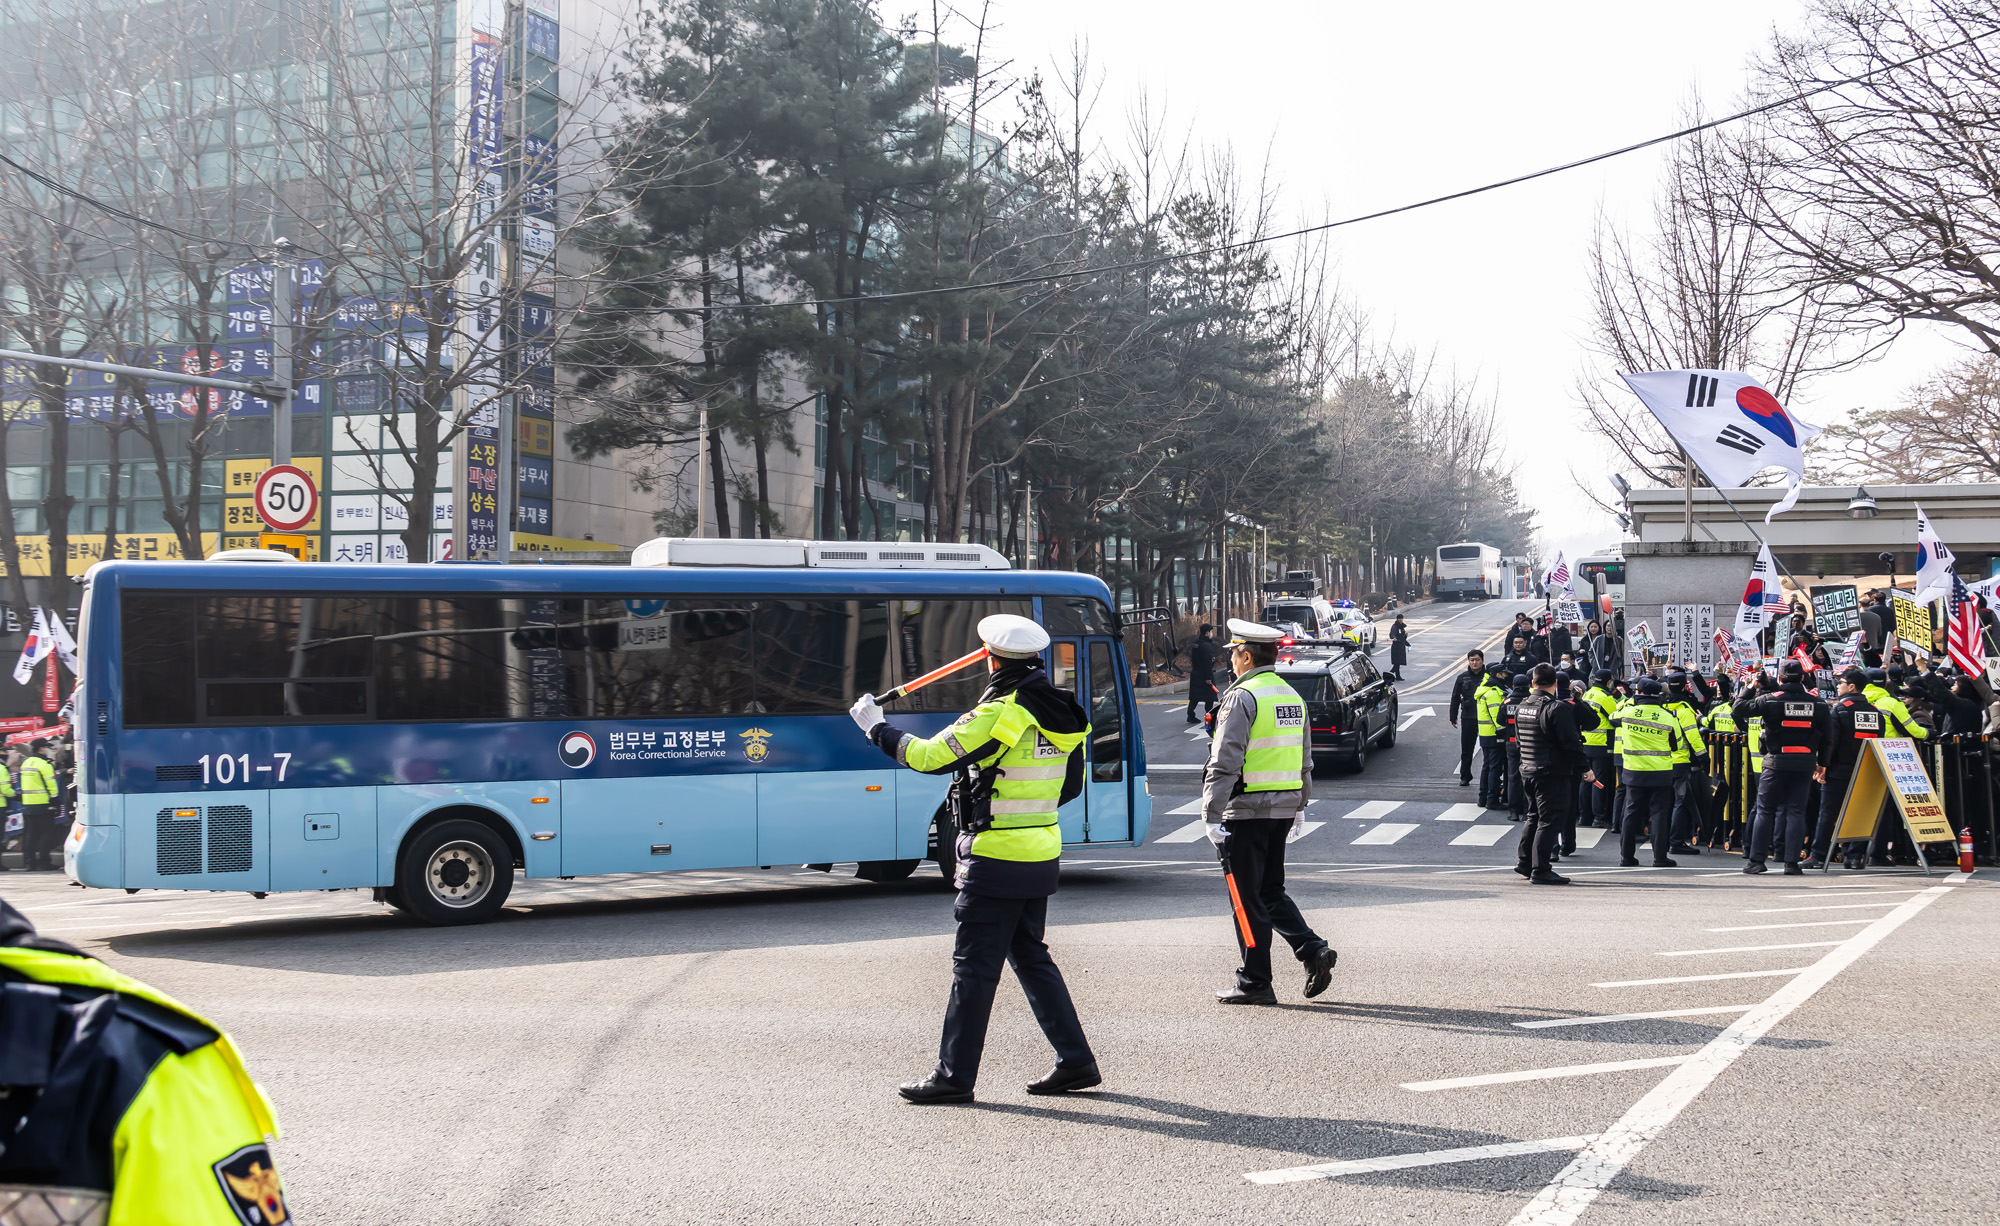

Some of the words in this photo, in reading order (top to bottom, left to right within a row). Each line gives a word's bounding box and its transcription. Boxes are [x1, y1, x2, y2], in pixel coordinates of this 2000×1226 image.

[469, 444, 497, 467] 소장
[469, 466, 497, 491] 파산
[268, 481, 305, 513] 50
[469, 492, 496, 514] 상속
[336, 507, 373, 518] 법무법인
[470, 517, 495, 532] 법무사
[18, 542, 43, 560] 무소
[335, 542, 374, 563] 大明
[385, 544, 408, 560] 개인
[1825, 588, 1856, 611] 힘내라
[1683, 606, 1694, 674] 서울중앙지방법
[1700, 606, 1711, 676] 서울고등법원
[1817, 670, 1834, 681] 대통
[1277, 706, 1302, 718] 교통경찰
[1634, 708, 1660, 721] 경찰
[1627, 724, 1663, 736] POLICE
[610, 731, 657, 750] 법무부
[663, 730, 726, 748] 교정본부
[610, 751, 636, 760] Korea
[638, 750, 692, 760] Correctional
[694, 749, 726, 758] Service
[1040, 747, 1067, 756] POLI
[1887, 752, 1900, 761] 외부
[1901, 752, 1914, 762] 차량
[198, 752, 292, 784] 101-7
[1904, 793, 1932, 804] 오토바이
[1916, 805, 1943, 817] 진입금지
